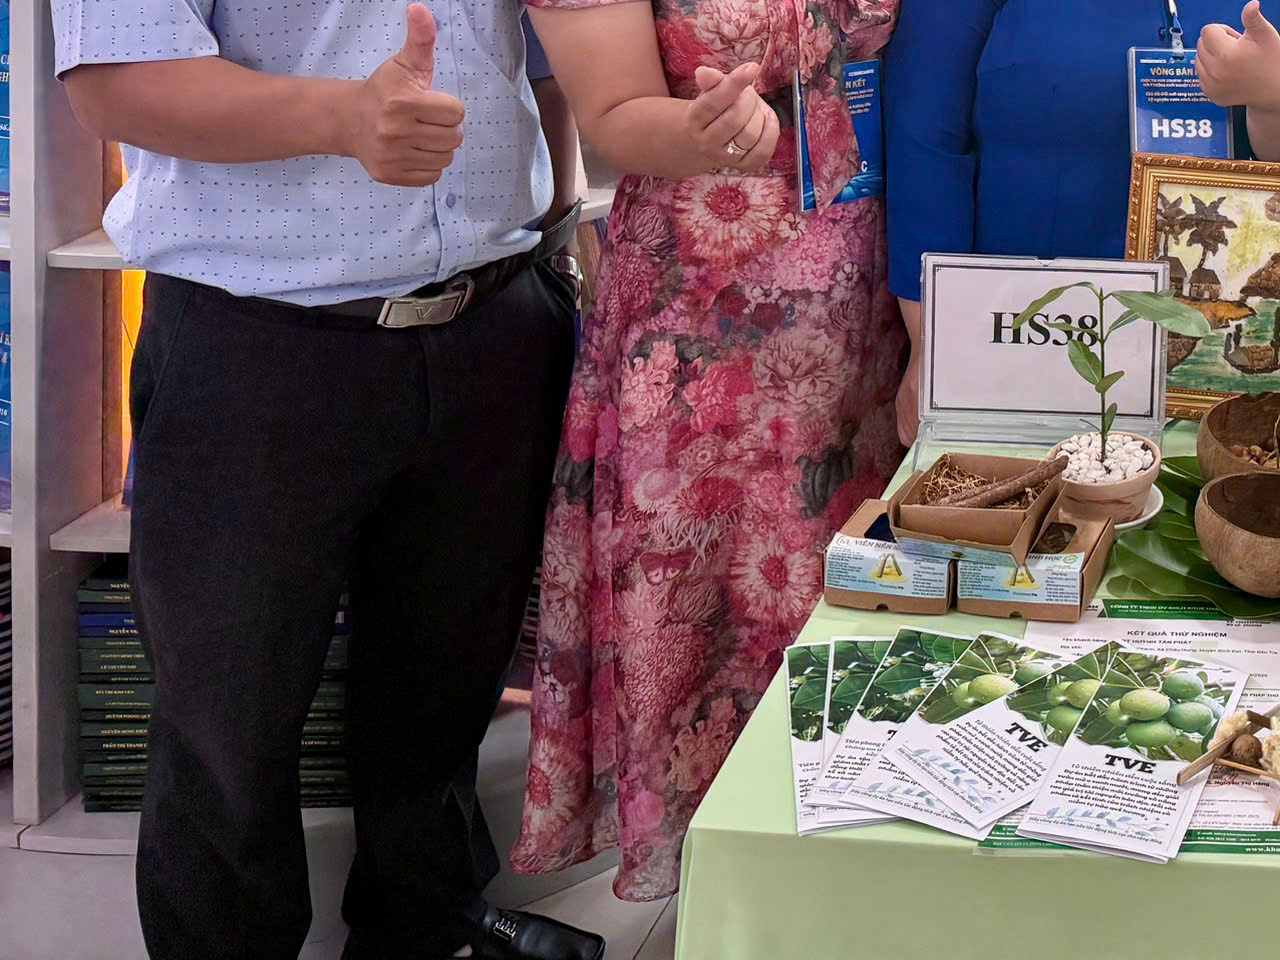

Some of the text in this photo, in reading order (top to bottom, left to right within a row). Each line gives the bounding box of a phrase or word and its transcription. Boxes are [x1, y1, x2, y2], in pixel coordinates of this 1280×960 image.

[1150, 67, 1193, 76] VÒNG BÁN
[1151, 118, 1213, 138] HS38
[990, 310, 1099, 346] HS38
[1127, 629, 1144, 637] KẾT
[1005, 721, 1049, 753] TVE
[1105, 754, 1157, 774] TVE
